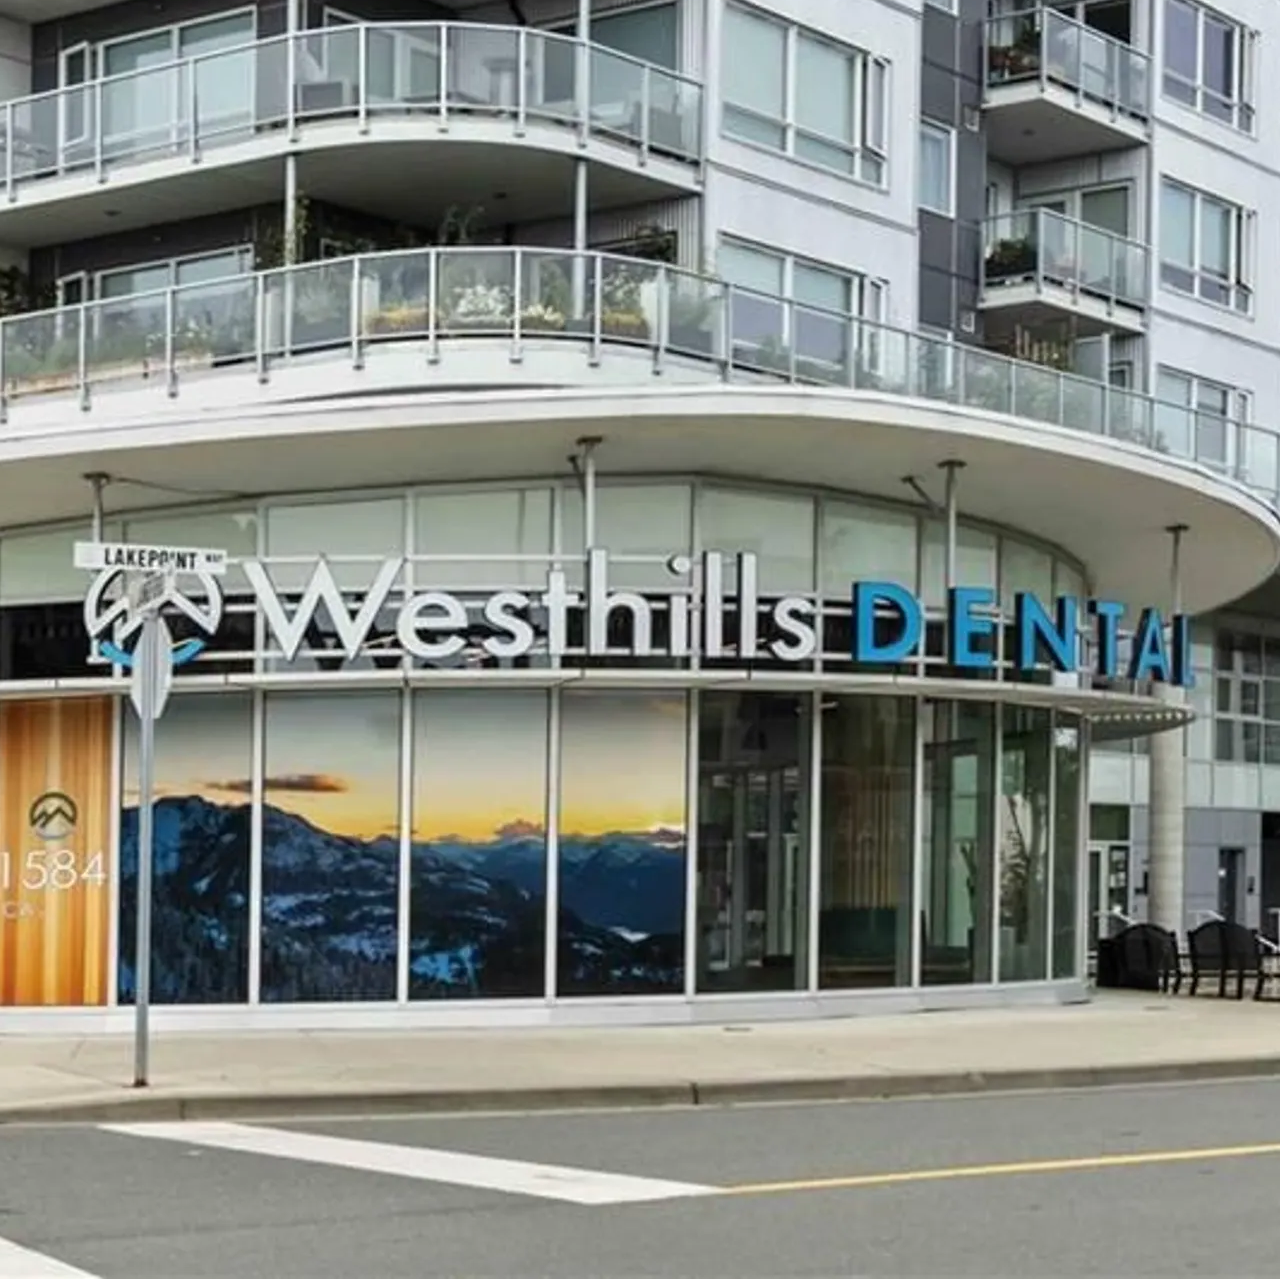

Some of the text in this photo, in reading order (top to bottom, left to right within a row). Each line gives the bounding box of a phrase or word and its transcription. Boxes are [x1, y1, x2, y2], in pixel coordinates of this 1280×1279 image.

[242, 548, 1197, 688] Westhills DENTAL
[1, 849, 108, 890] 1584
